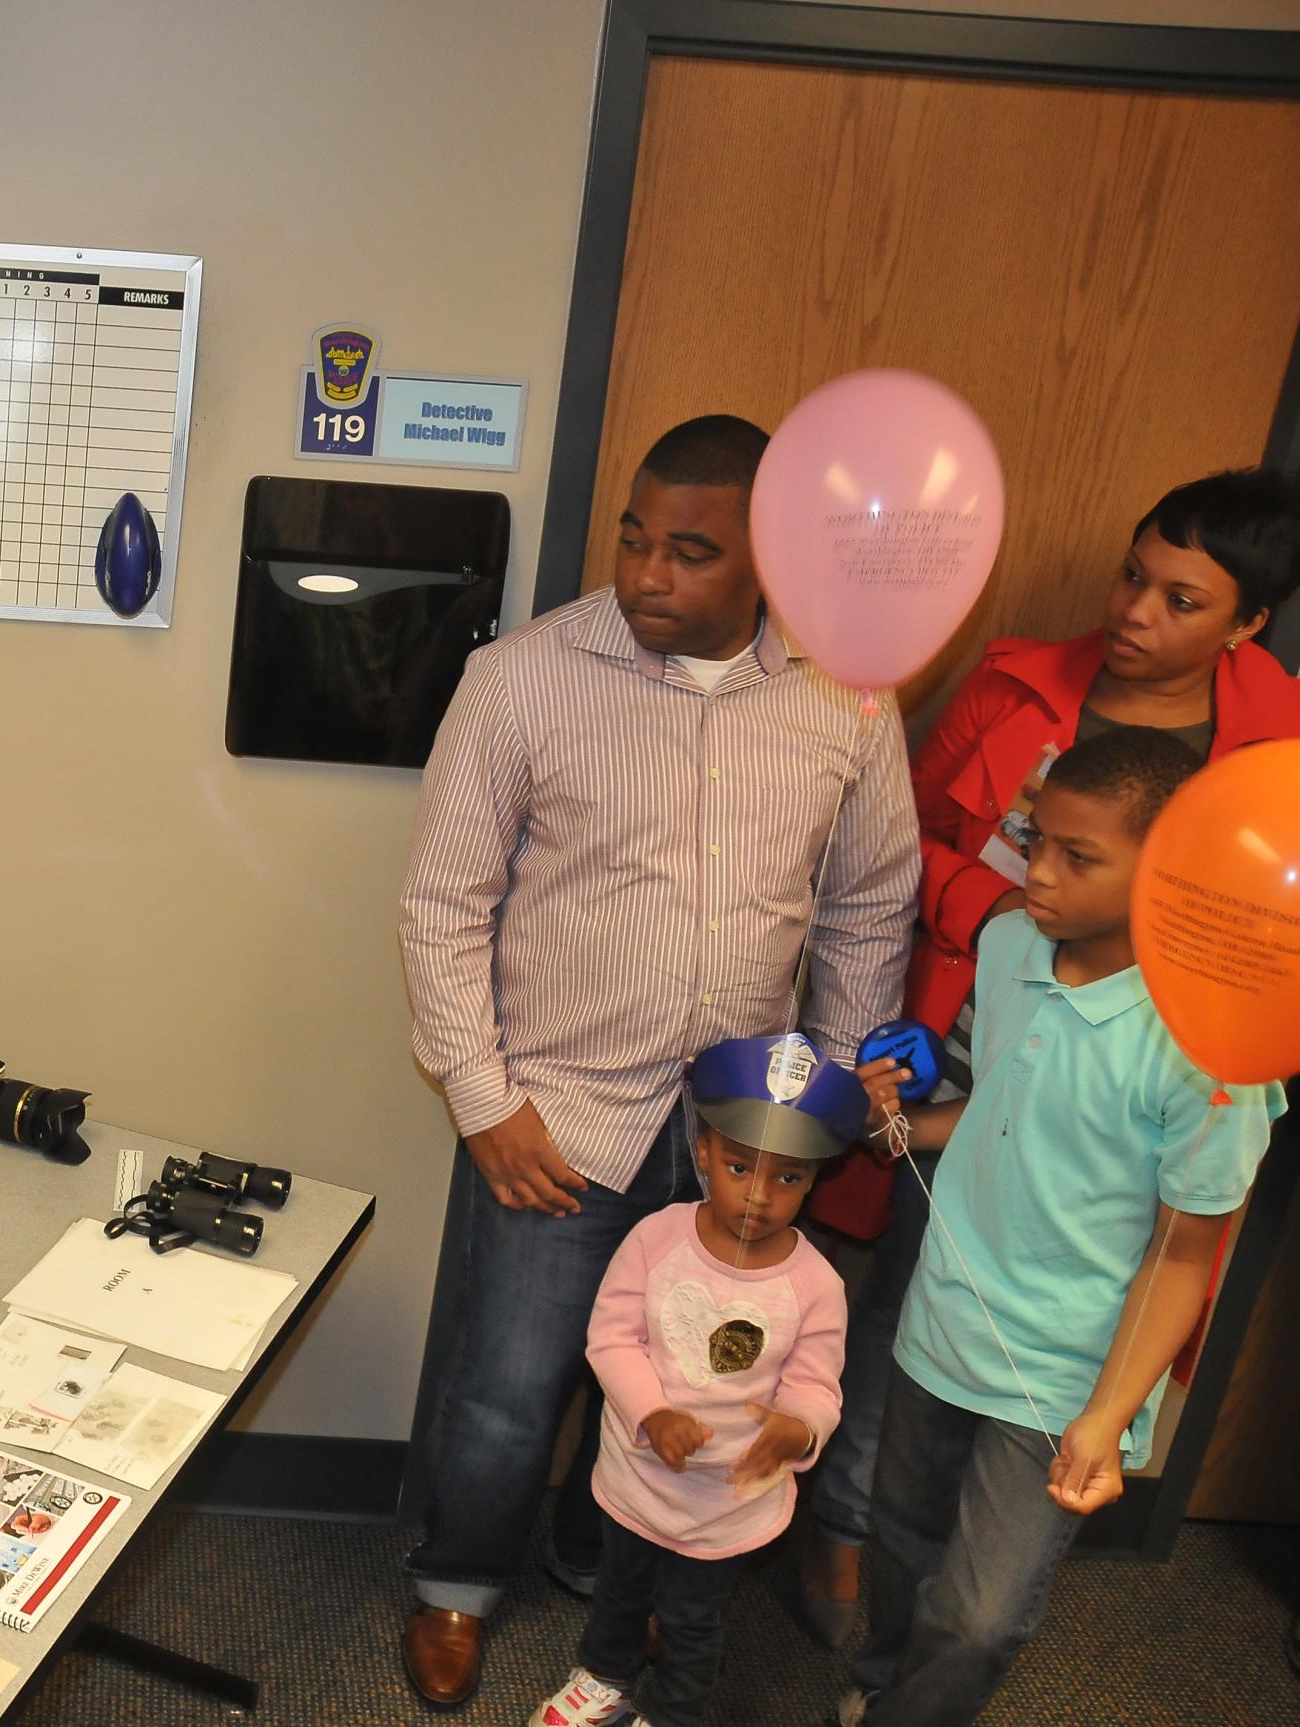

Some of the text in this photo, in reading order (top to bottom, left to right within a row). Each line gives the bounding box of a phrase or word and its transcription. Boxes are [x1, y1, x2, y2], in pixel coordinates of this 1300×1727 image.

[4, 283, 8, 295] 1
[23, 285, 30, 296] 2
[43, 286, 51, 297] 3
[64, 287, 71, 299] 4
[84, 289, 92, 300] 5
[123, 291, 169, 305] REMARKS
[421, 402, 493, 421] Detective
[313, 413, 365, 442] 119
[404, 423, 506, 446] Michael Wigg
[103, 1269, 131, 1292] ROOM
